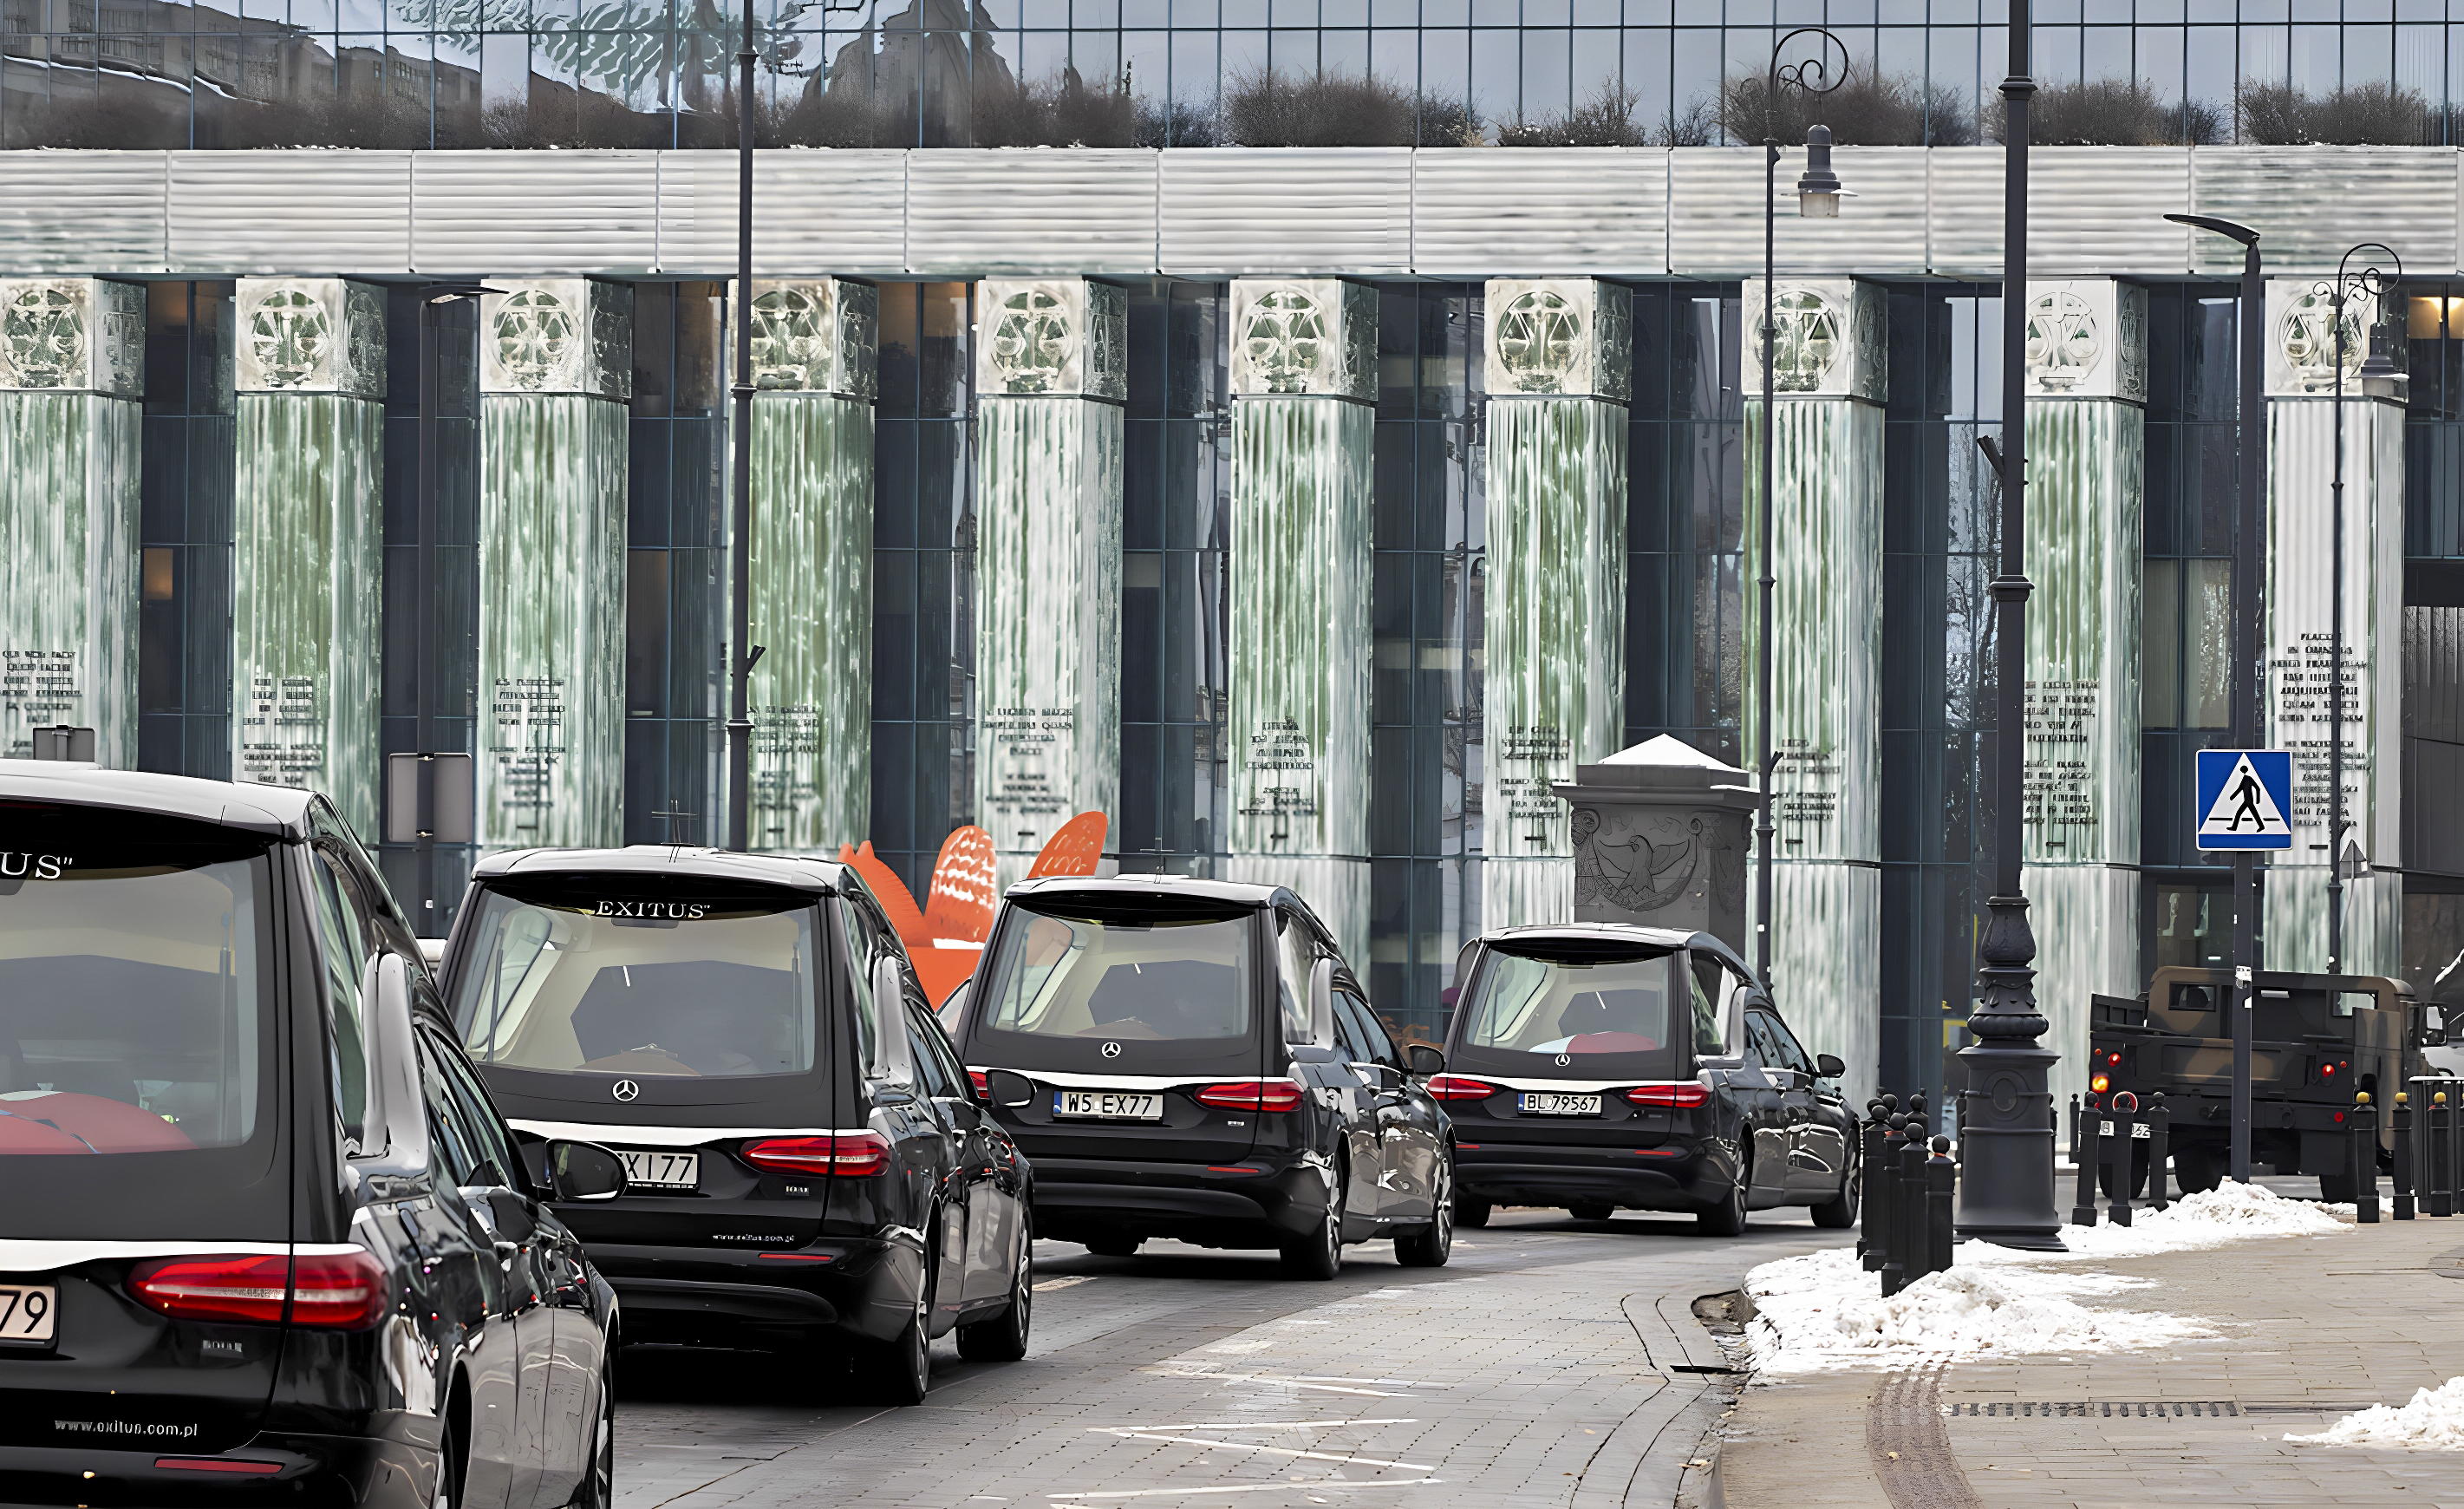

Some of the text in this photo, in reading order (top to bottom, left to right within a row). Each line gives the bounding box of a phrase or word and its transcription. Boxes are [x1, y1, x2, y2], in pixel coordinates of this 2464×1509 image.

[1102, 1094, 1153, 1115] EX77
[1528, 1094, 1599, 1112] BL 79567
